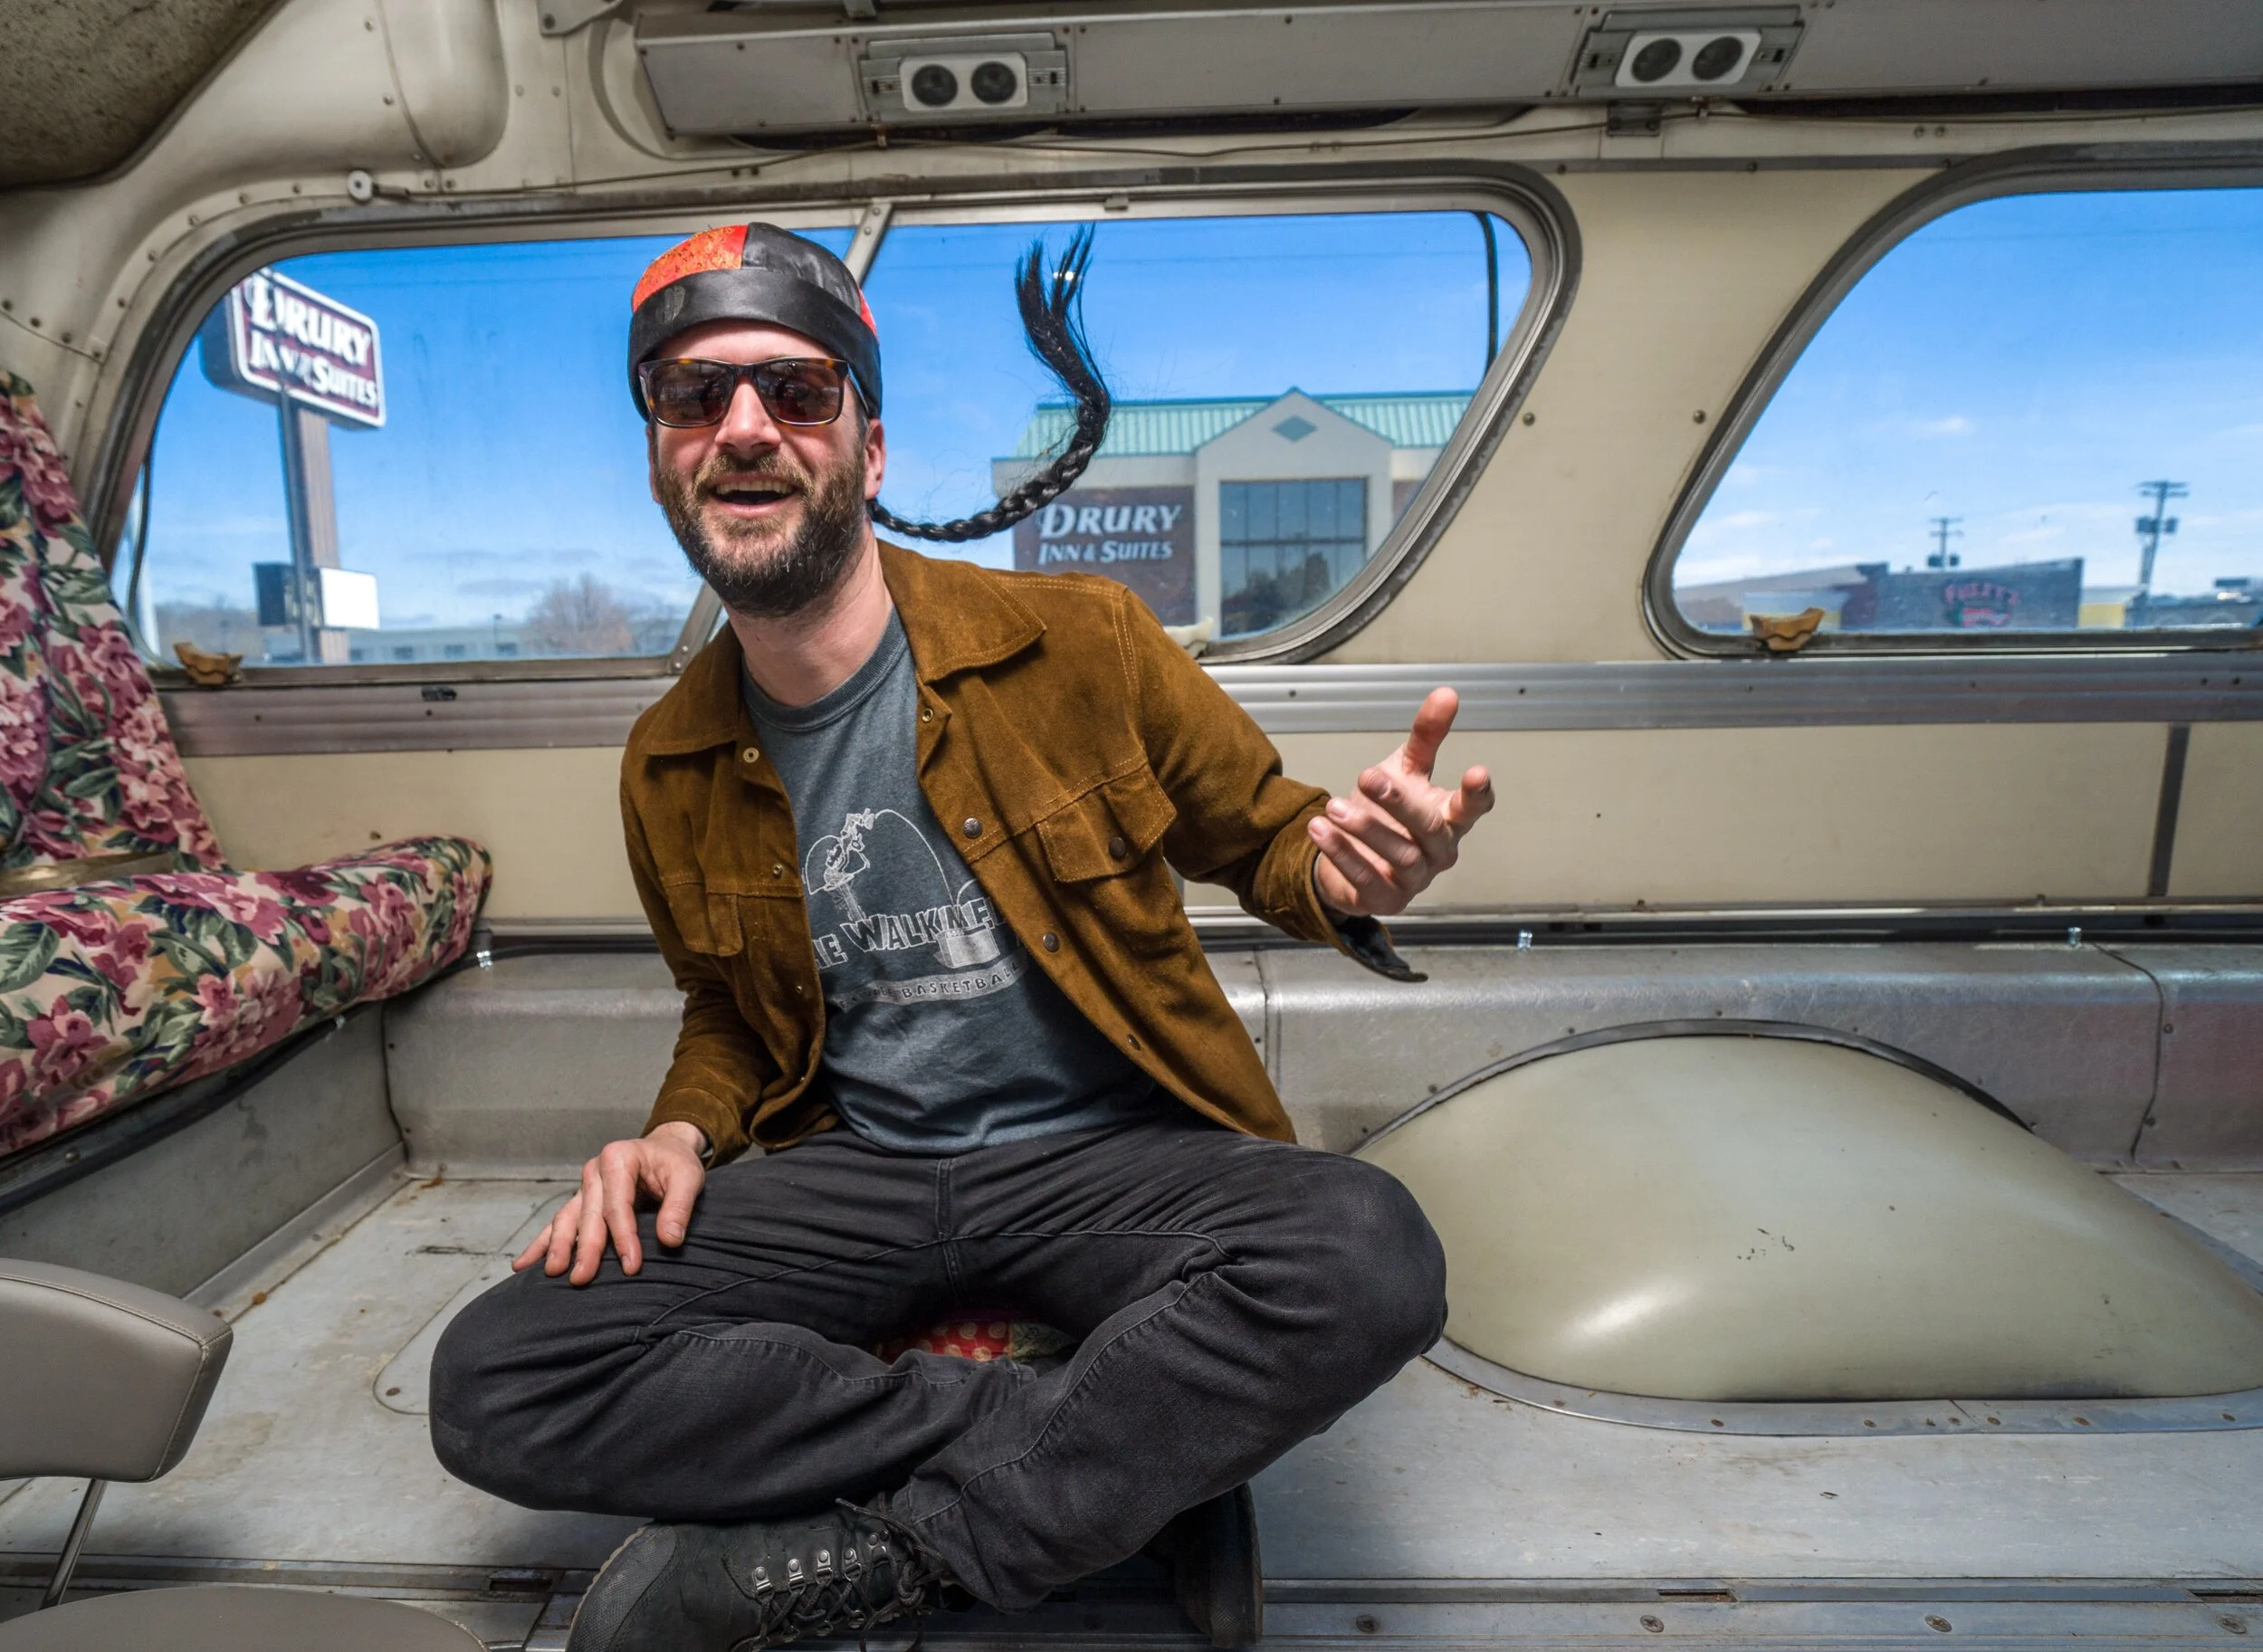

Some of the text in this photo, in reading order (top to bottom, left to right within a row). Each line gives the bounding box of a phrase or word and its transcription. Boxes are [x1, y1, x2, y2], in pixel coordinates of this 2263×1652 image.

[244, 273, 371, 367] DRURY
[250, 329, 297, 373] INN
[312, 355, 377, 406] SUITES
[1036, 502, 1182, 540] DRURY
[1038, 540, 1173, 566] INN & SUITES
[901, 960, 1020, 999] BASKETBALL
